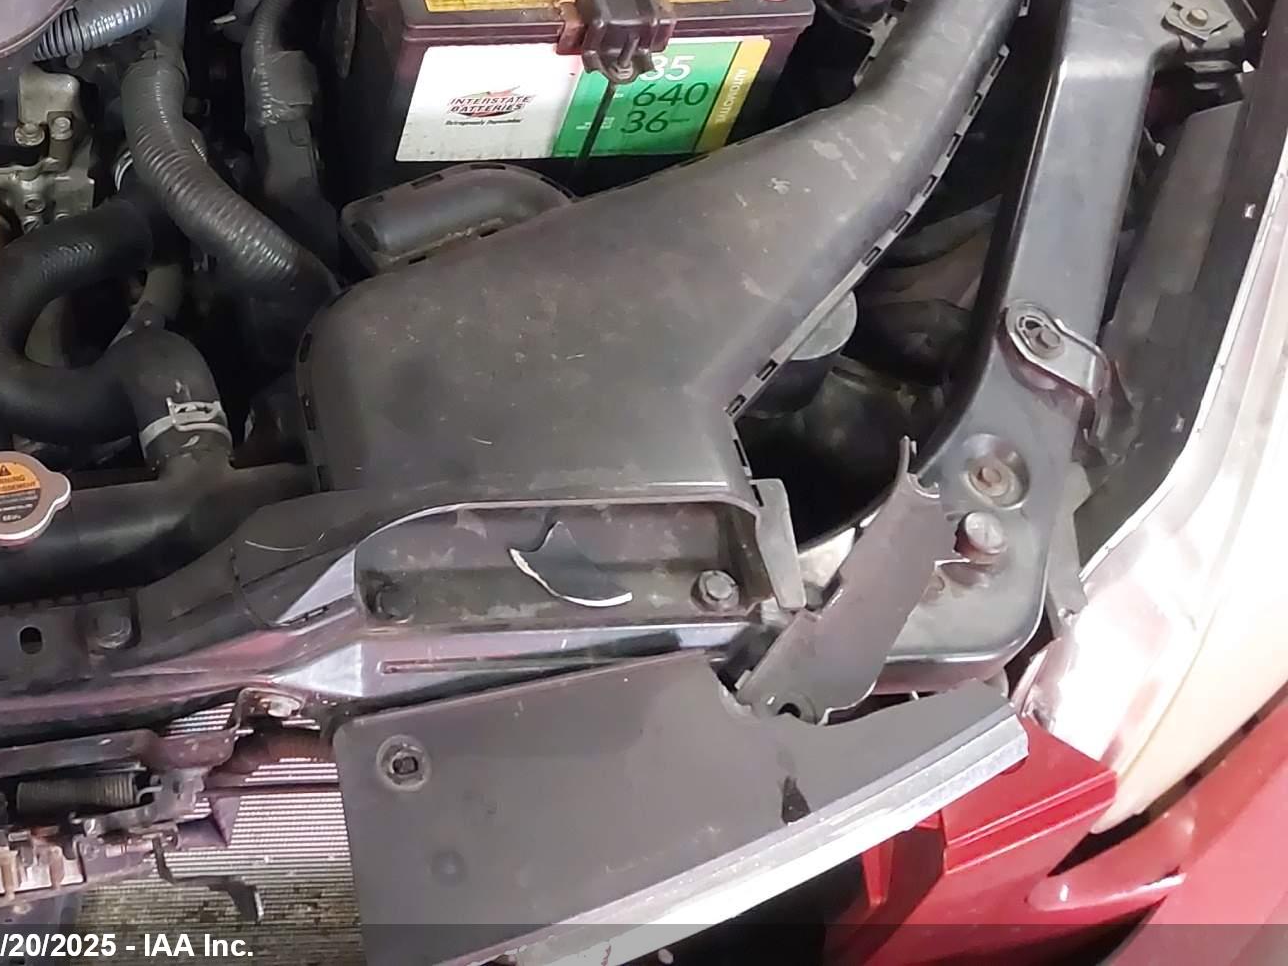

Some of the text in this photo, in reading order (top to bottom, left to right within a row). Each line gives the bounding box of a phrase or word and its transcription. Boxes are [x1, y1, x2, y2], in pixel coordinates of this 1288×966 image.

[450, 95, 531, 105] INTERSTATE
[632, 82, 710, 106] 640
[715, 68, 748, 124] AUTOMOTIVE
[450, 103, 523, 112] BATTERIES
